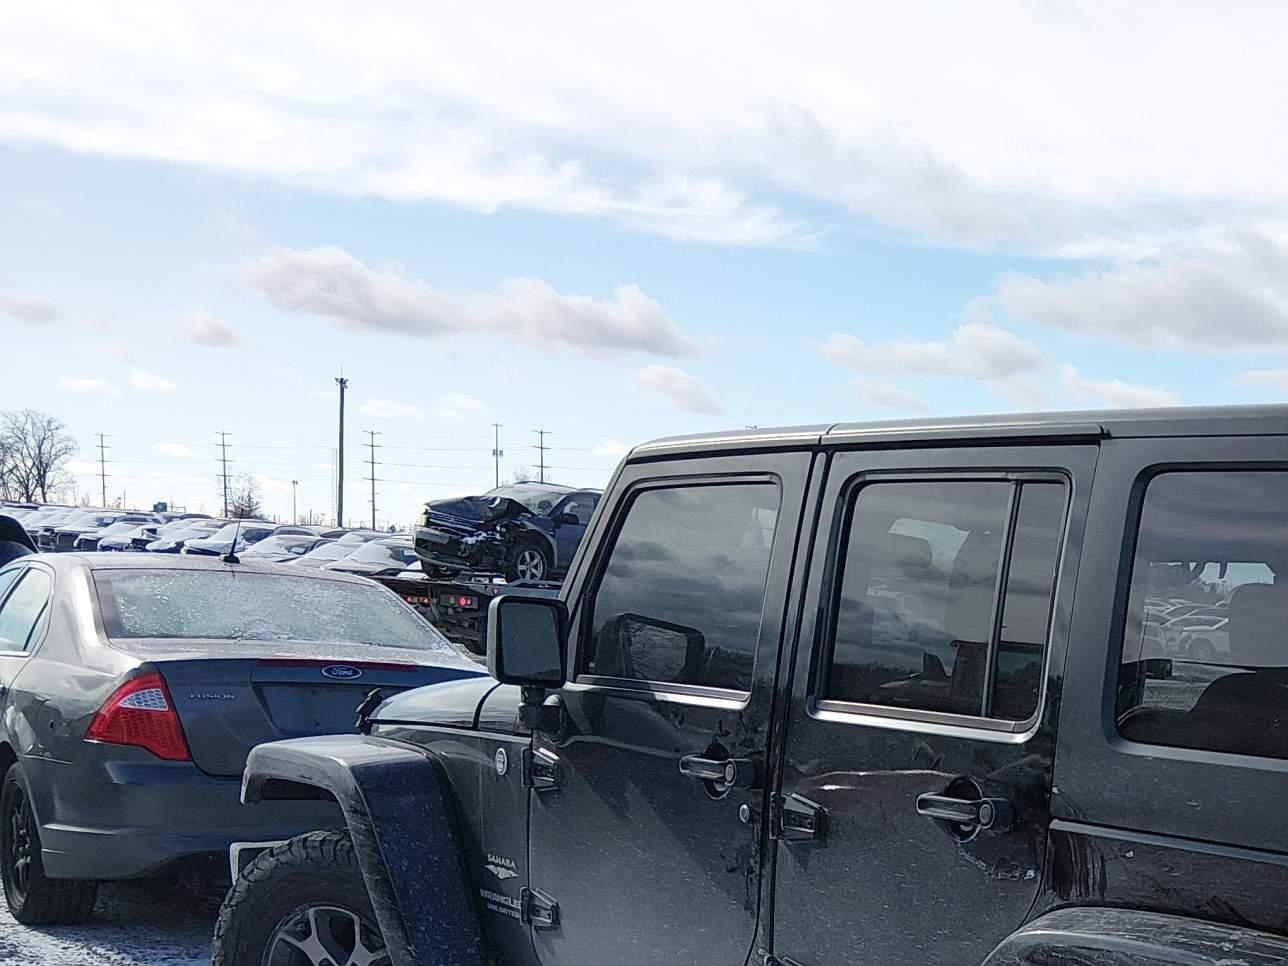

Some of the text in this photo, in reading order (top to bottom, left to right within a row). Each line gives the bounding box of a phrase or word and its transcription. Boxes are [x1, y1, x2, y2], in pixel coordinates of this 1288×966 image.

[330, 666, 354, 677] Ford
[189, 692, 236, 700] FUSION
[487, 853, 517, 869] SAHARA
